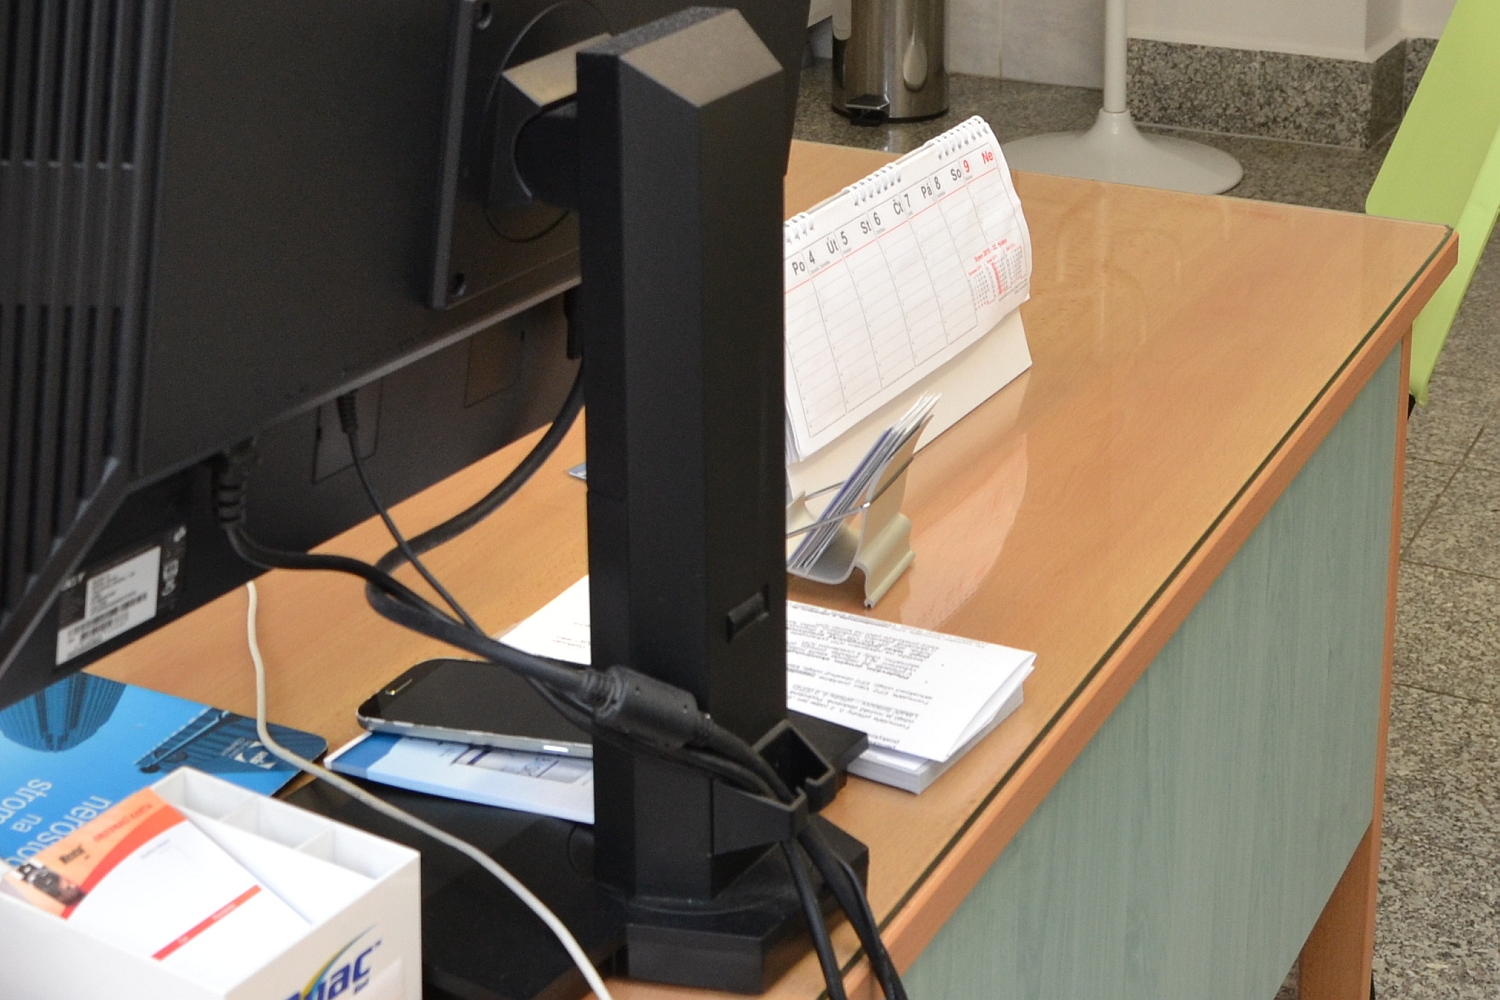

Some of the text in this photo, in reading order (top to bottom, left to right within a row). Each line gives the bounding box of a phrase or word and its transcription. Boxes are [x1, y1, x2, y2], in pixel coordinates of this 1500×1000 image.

[791, 261, 806, 276] Po
[808, 250, 815, 265] 4
[826, 237, 839, 255] Út
[840, 231, 848, 245] 5
[860, 220, 872, 235] St
[873, 212, 881, 226] 6
[892, 199, 904, 216] Čt
[904, 193, 911, 208] 7
[920, 184, 933, 199] Pá
[934, 176, 941, 190] 8
[950, 168, 962, 182] So
[963, 160, 970, 173] 9
[981, 150, 994, 165] Ne
[10, 813, 43, 834] na
